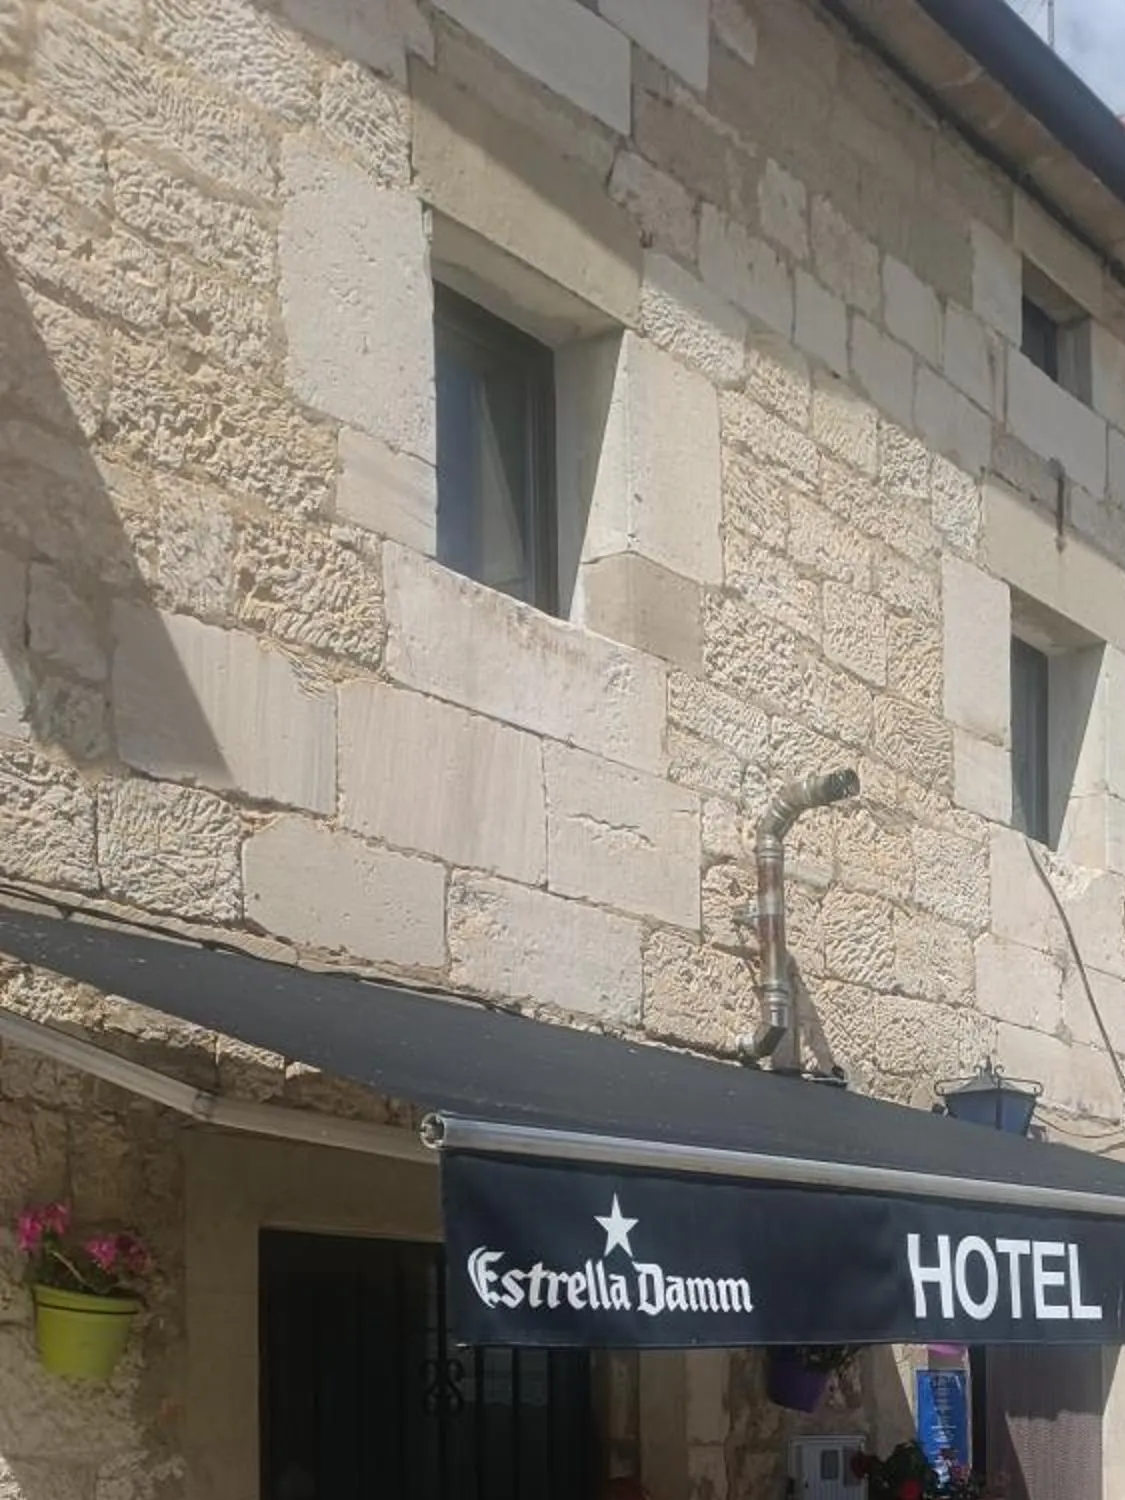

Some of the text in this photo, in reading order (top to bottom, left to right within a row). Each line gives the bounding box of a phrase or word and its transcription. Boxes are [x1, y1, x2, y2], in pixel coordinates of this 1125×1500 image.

[467, 1246, 754, 1316] Estrella Damm
[906, 1232, 1103, 1321] HOTEL
